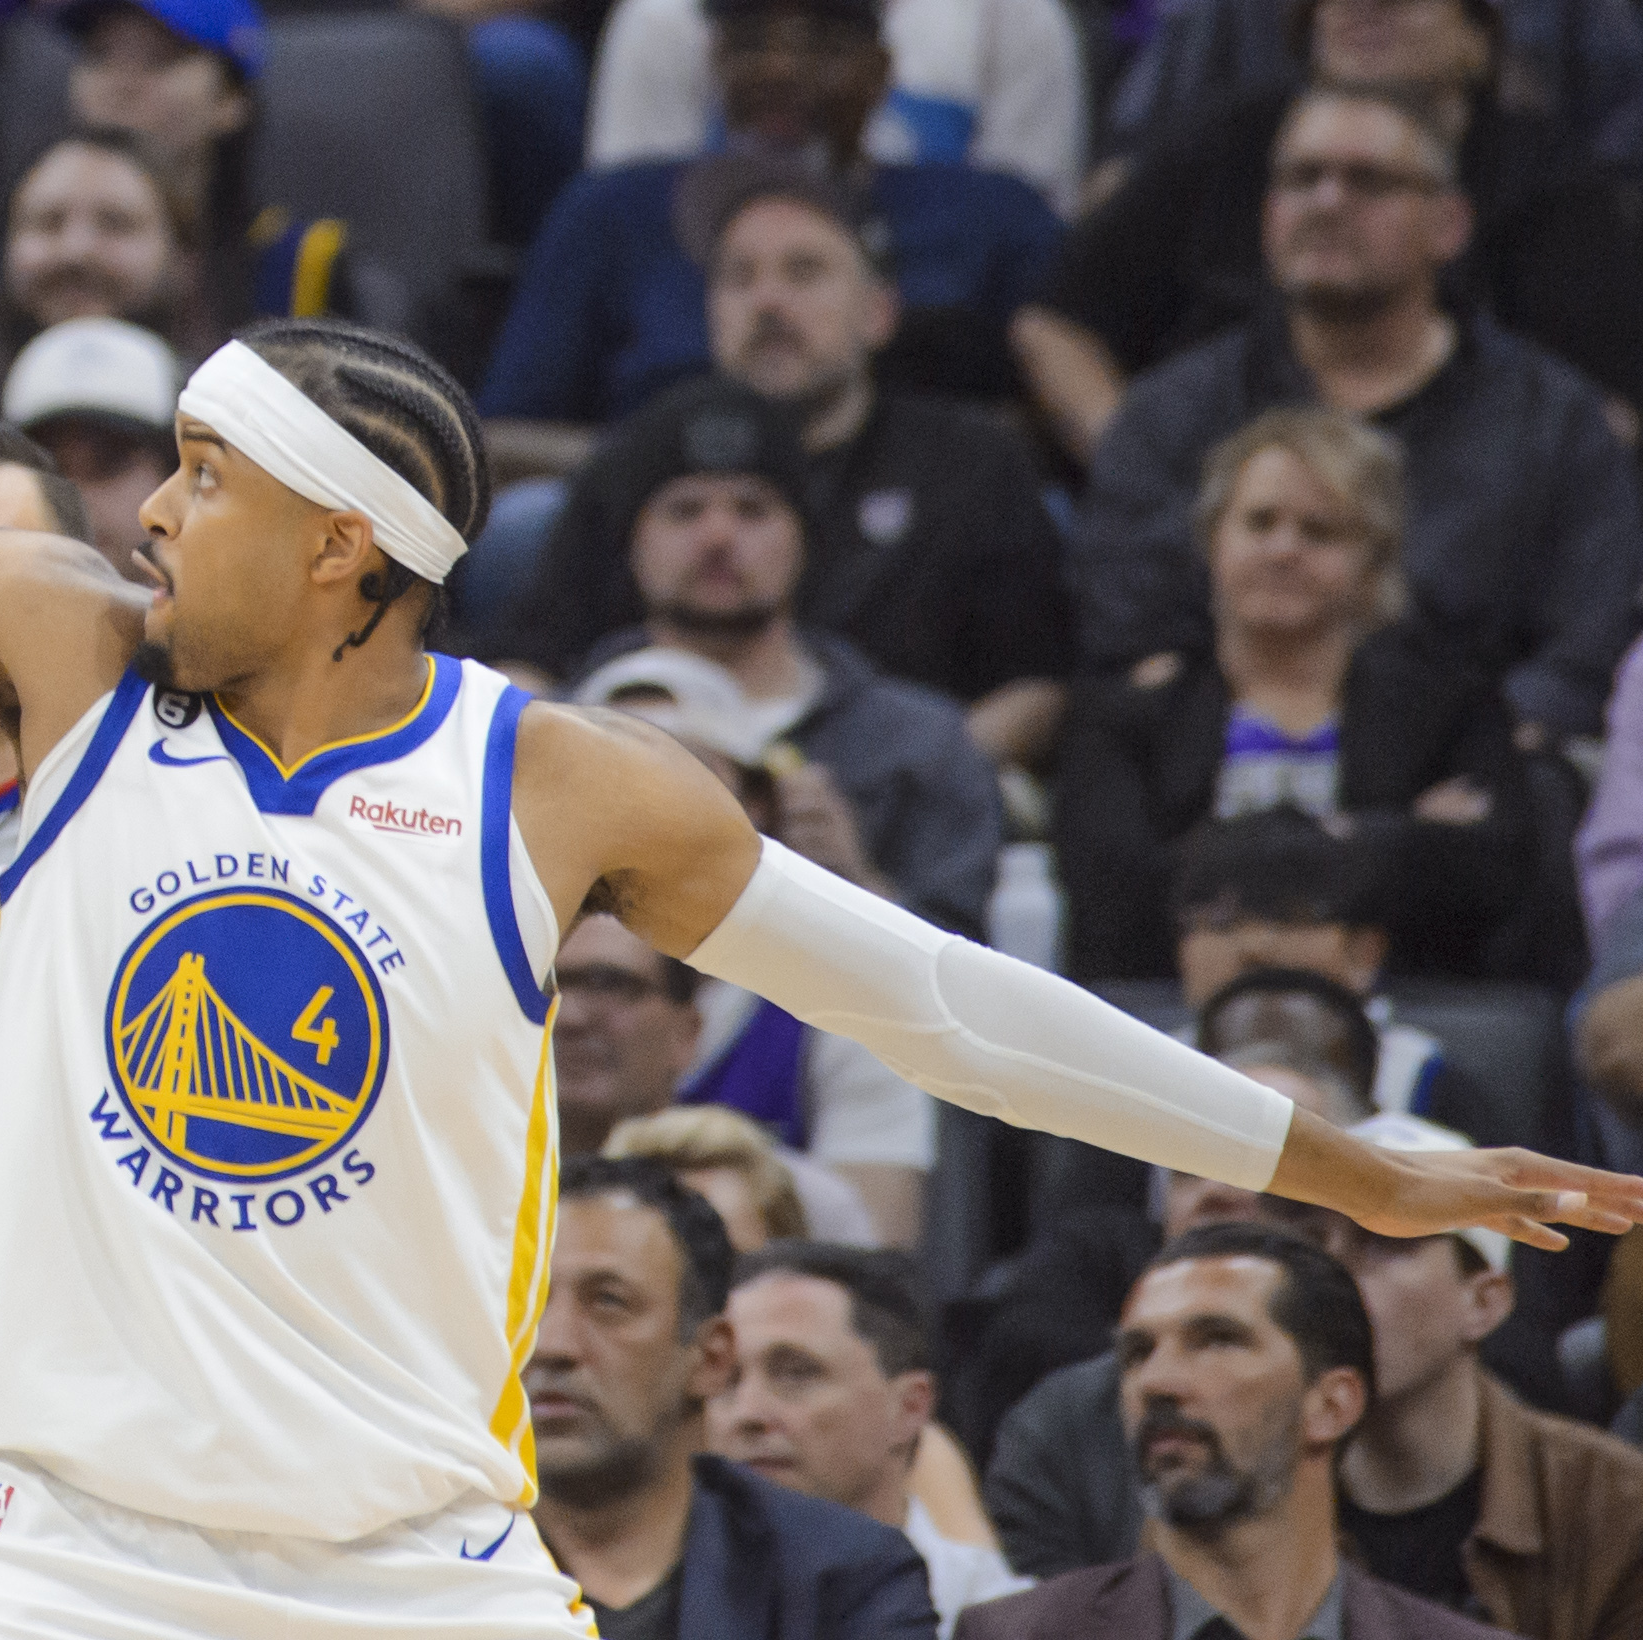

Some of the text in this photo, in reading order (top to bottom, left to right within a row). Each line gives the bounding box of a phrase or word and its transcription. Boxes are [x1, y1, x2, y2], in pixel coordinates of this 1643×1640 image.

[156, 689, 189, 727] 6
[348, 794, 463, 837] Rakuten
[129, 852, 407, 976] GOLDEN STATE
[291, 986, 341, 1066] 4
[87, 1086, 377, 1232] WARRIORS
